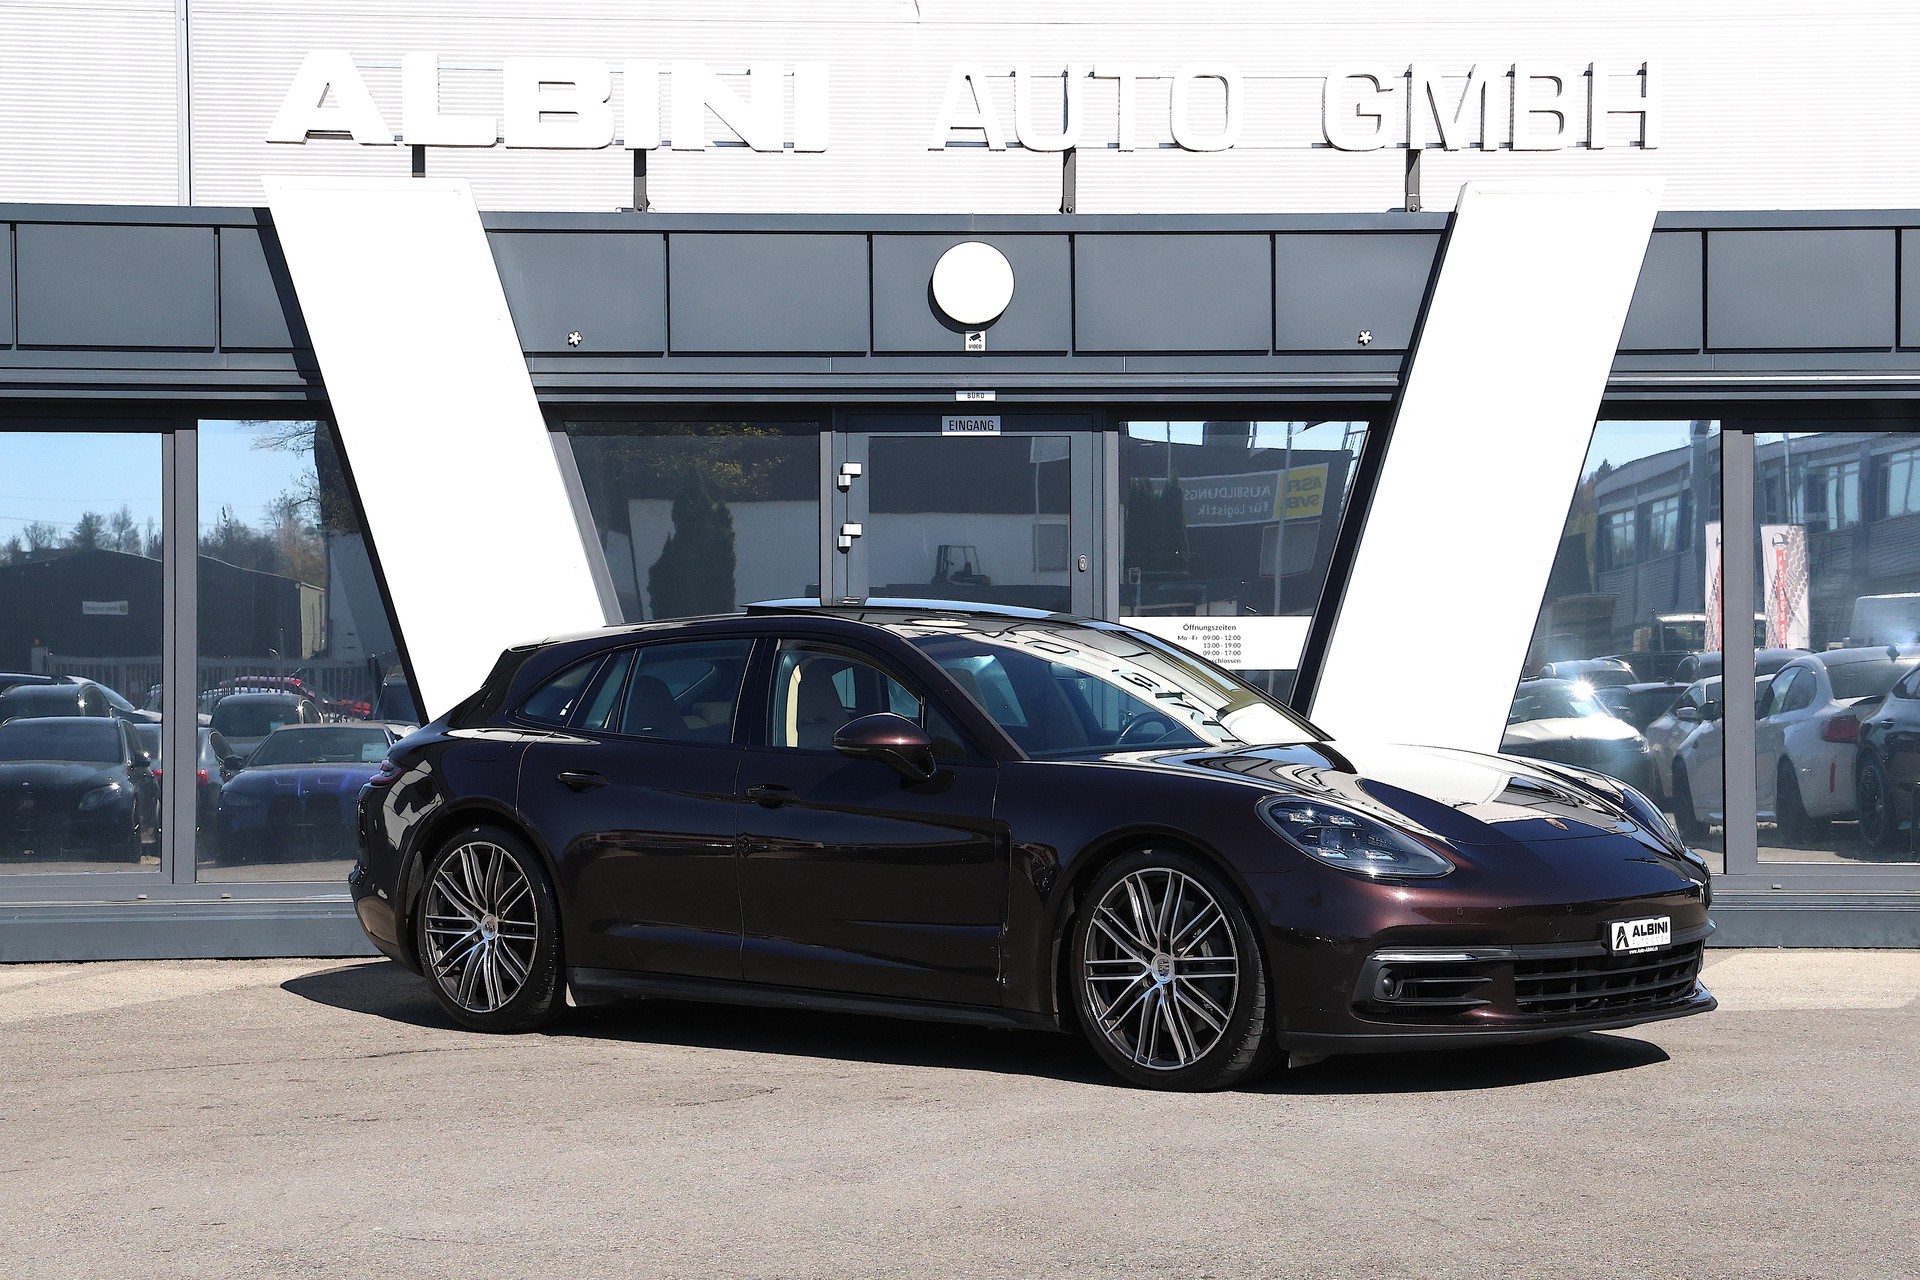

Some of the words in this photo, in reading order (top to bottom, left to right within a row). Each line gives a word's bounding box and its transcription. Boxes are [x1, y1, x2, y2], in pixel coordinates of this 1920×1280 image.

[265, 49, 829, 153] ALBINI
[928, 60, 1244, 153] AUTO
[1322, 60, 1660, 153] GMBH
[967, 391, 985, 399] BÜRO
[949, 420, 994, 431] EINGANG
[1183, 623, 1237, 632] Öffnungszeiten
[1632, 921, 1668, 937] ALBINI
